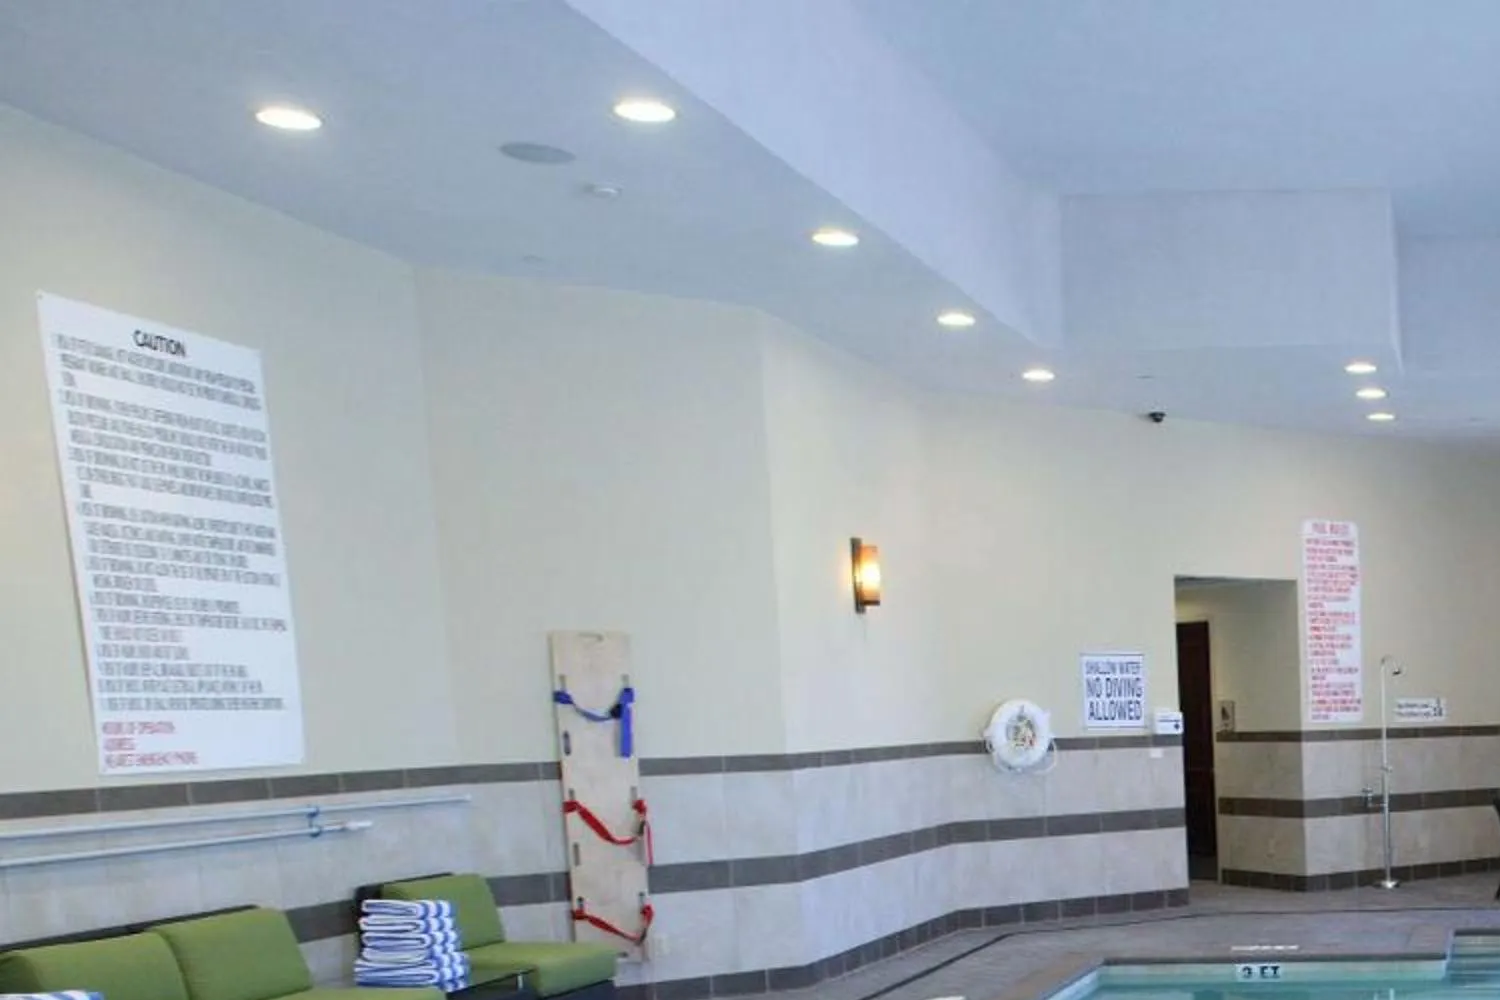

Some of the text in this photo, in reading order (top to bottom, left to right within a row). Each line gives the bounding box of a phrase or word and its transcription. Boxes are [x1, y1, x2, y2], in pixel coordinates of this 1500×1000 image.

[133, 330, 186, 357] CAUTION
[1086, 677, 1143, 698] NO DIVING
[1088, 700, 1142, 721] ALLOWED
